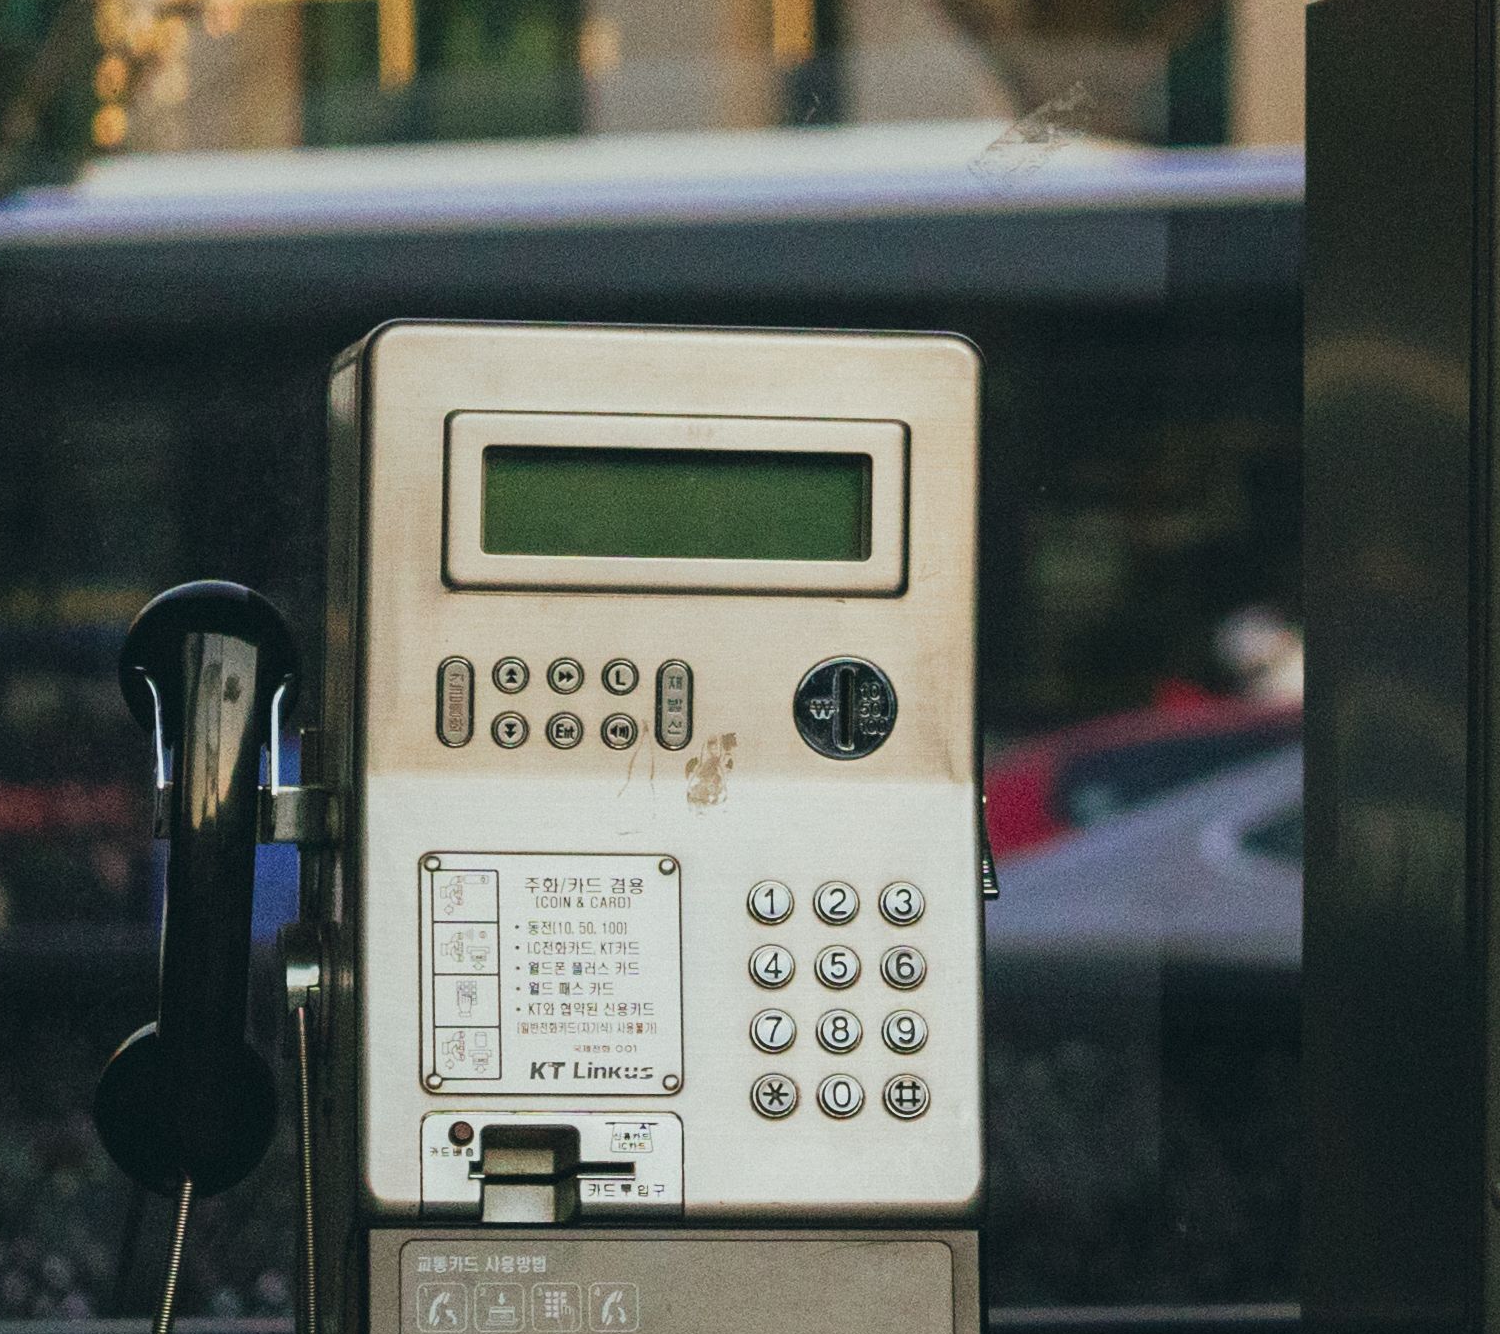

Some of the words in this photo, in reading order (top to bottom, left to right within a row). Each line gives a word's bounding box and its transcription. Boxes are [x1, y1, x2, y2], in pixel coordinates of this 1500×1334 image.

[524, 877, 603, 894] 주화/카드
[611, 877, 644, 895] 겸용
[576, 896, 584, 908] &
[765, 888, 774, 914] 1
[829, 888, 847, 915] 2
[895, 889, 912, 915] 3
[600, 942, 640, 955] KT카드
[528, 962, 566, 976] 월드폰
[572, 962, 610, 976] 플러스
[615, 962, 640, 976] 카드
[764, 952, 782, 979] 4
[831, 952, 847, 980] 5
[896, 953, 915, 980] 6
[528, 982, 554, 996] 월드
[559, 982, 584, 996] 패스
[589, 982, 615, 997] 카드
[528, 1002, 555, 1016] KT와
[560, 1002, 599, 1017] 협약된
[604, 1002, 655, 1017] 신용카드
[765, 1017, 783, 1043] 7
[832, 1017, 850, 1043] 8
[897, 1017, 915, 1044] 9
[529, 1061, 566, 1080] KT
[573, 1061, 654, 1080] Linkus
[833, 1081, 851, 1108] 0
